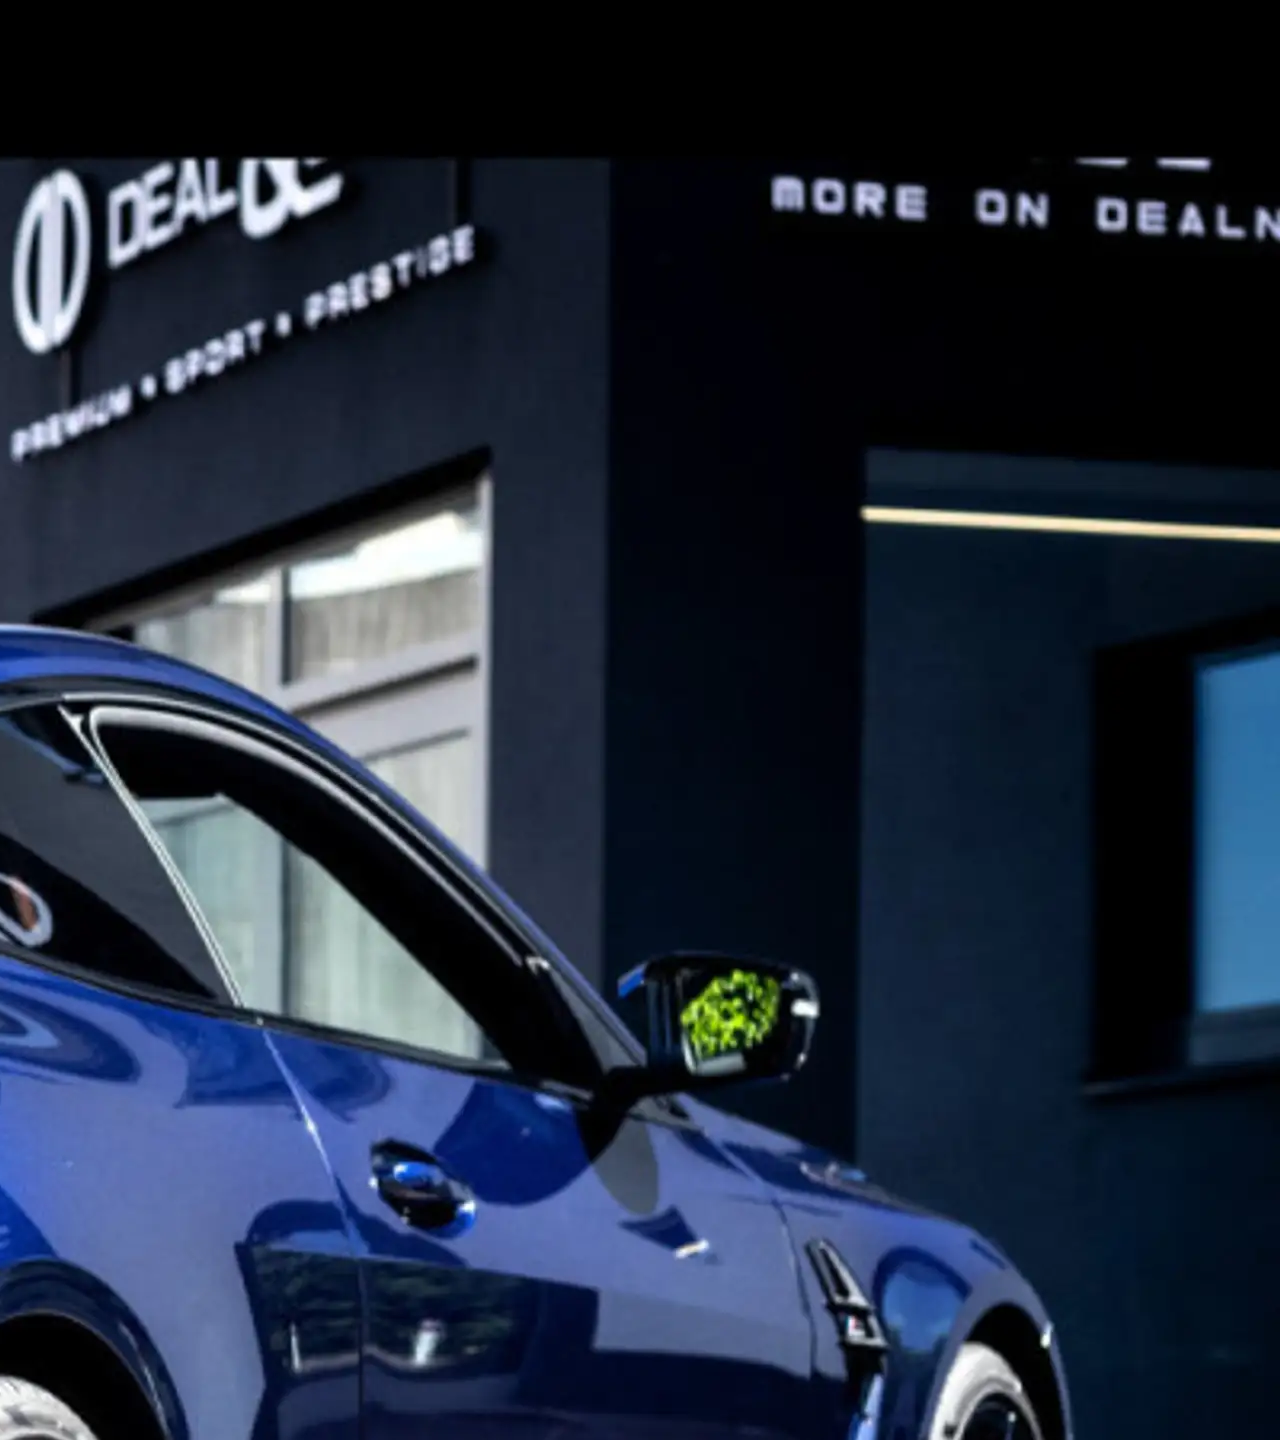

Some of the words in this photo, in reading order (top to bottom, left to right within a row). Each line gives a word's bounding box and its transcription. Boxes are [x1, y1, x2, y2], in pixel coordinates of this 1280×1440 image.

[771, 175, 928, 221] MORE
[975, 189, 1049, 227] ON
[10, 383, 133, 463] PREMIUM
[164, 318, 267, 394] SPORT
[303, 223, 476, 328] PRESTIGE
